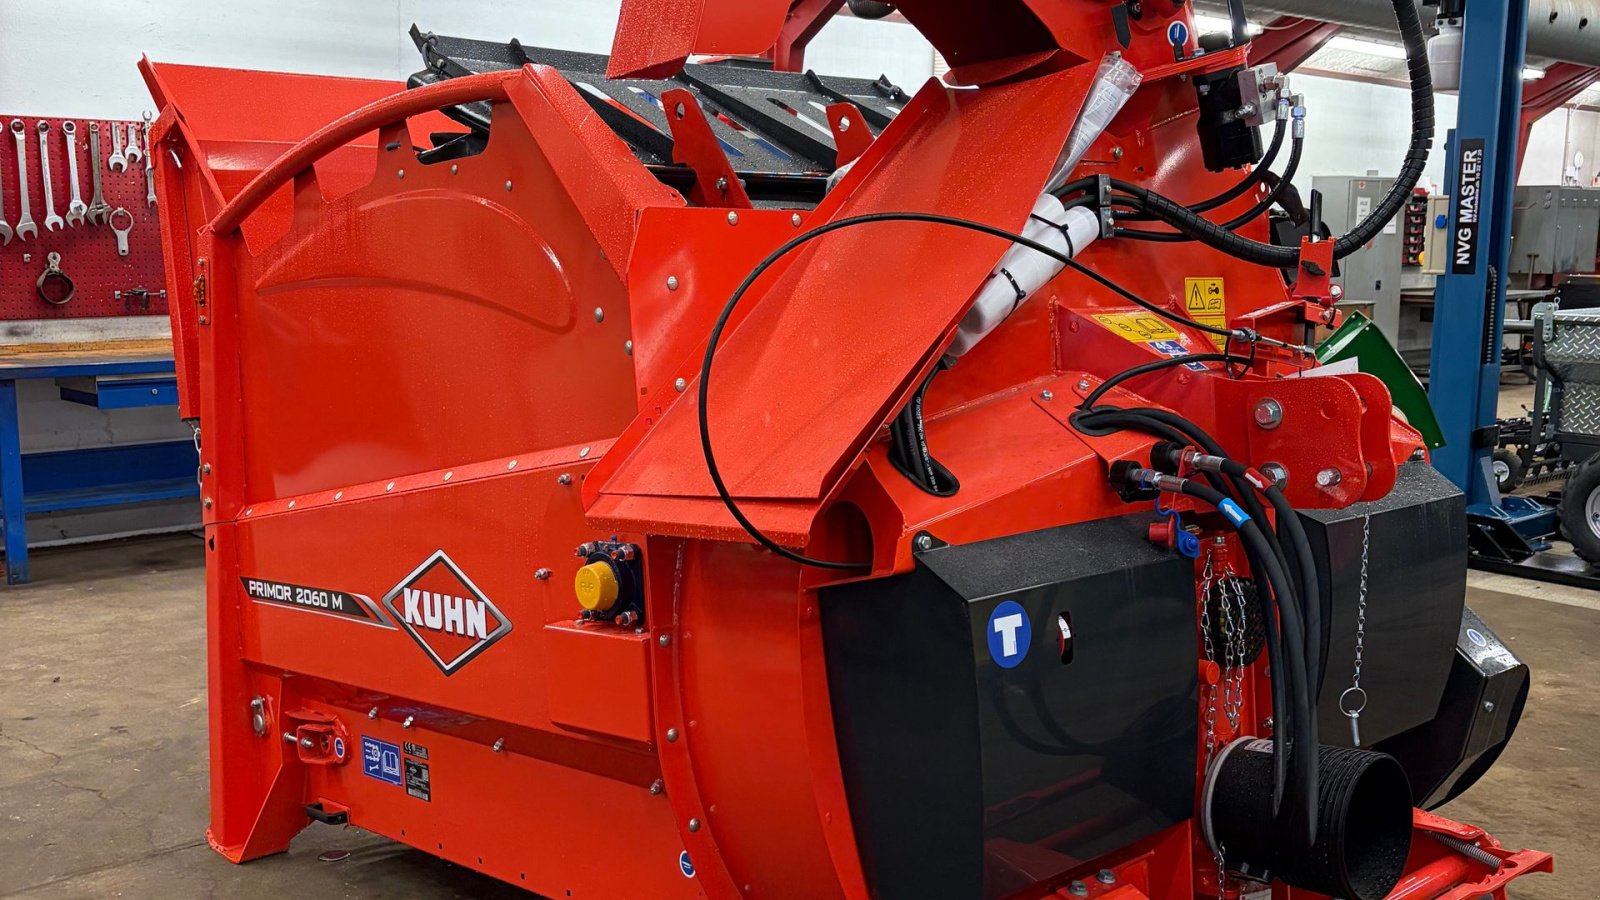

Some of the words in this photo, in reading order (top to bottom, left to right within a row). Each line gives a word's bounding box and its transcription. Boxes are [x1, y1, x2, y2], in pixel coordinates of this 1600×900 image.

[1460, 150, 1477, 223] MASTER
[1456, 227, 1472, 265] NVG
[249, 580, 292, 601] PRIMOR
[296, 588, 328, 608] 2060
[332, 595, 343, 610] M
[403, 587, 487, 640] KUHN
[993, 612, 1023, 657] T
